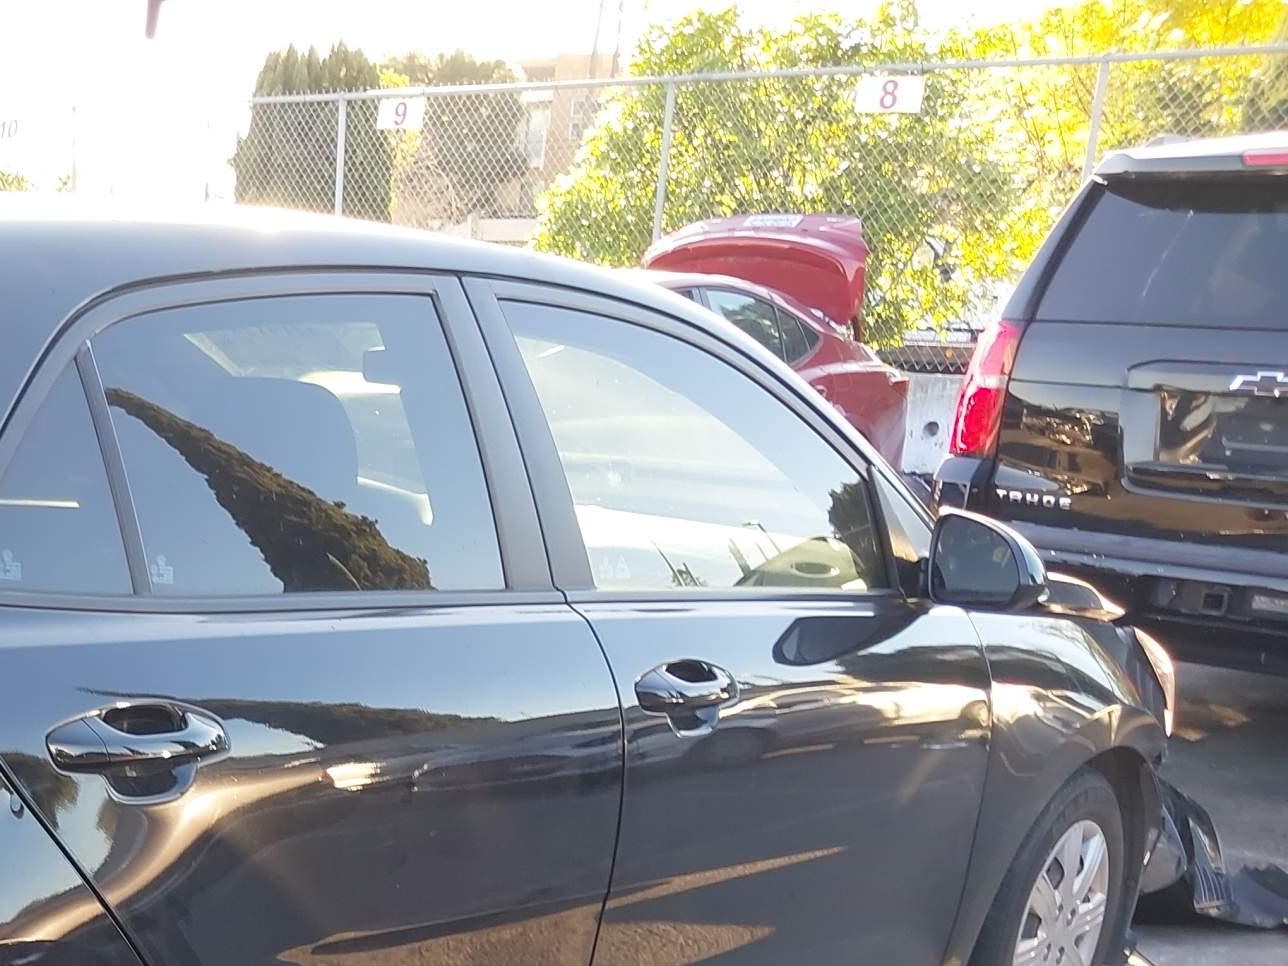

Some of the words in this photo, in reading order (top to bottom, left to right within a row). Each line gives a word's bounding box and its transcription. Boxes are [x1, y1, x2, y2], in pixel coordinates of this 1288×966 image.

[879, 79, 899, 110] 8
[393, 101, 408, 126] 9
[0, 119, 19, 139] 10
